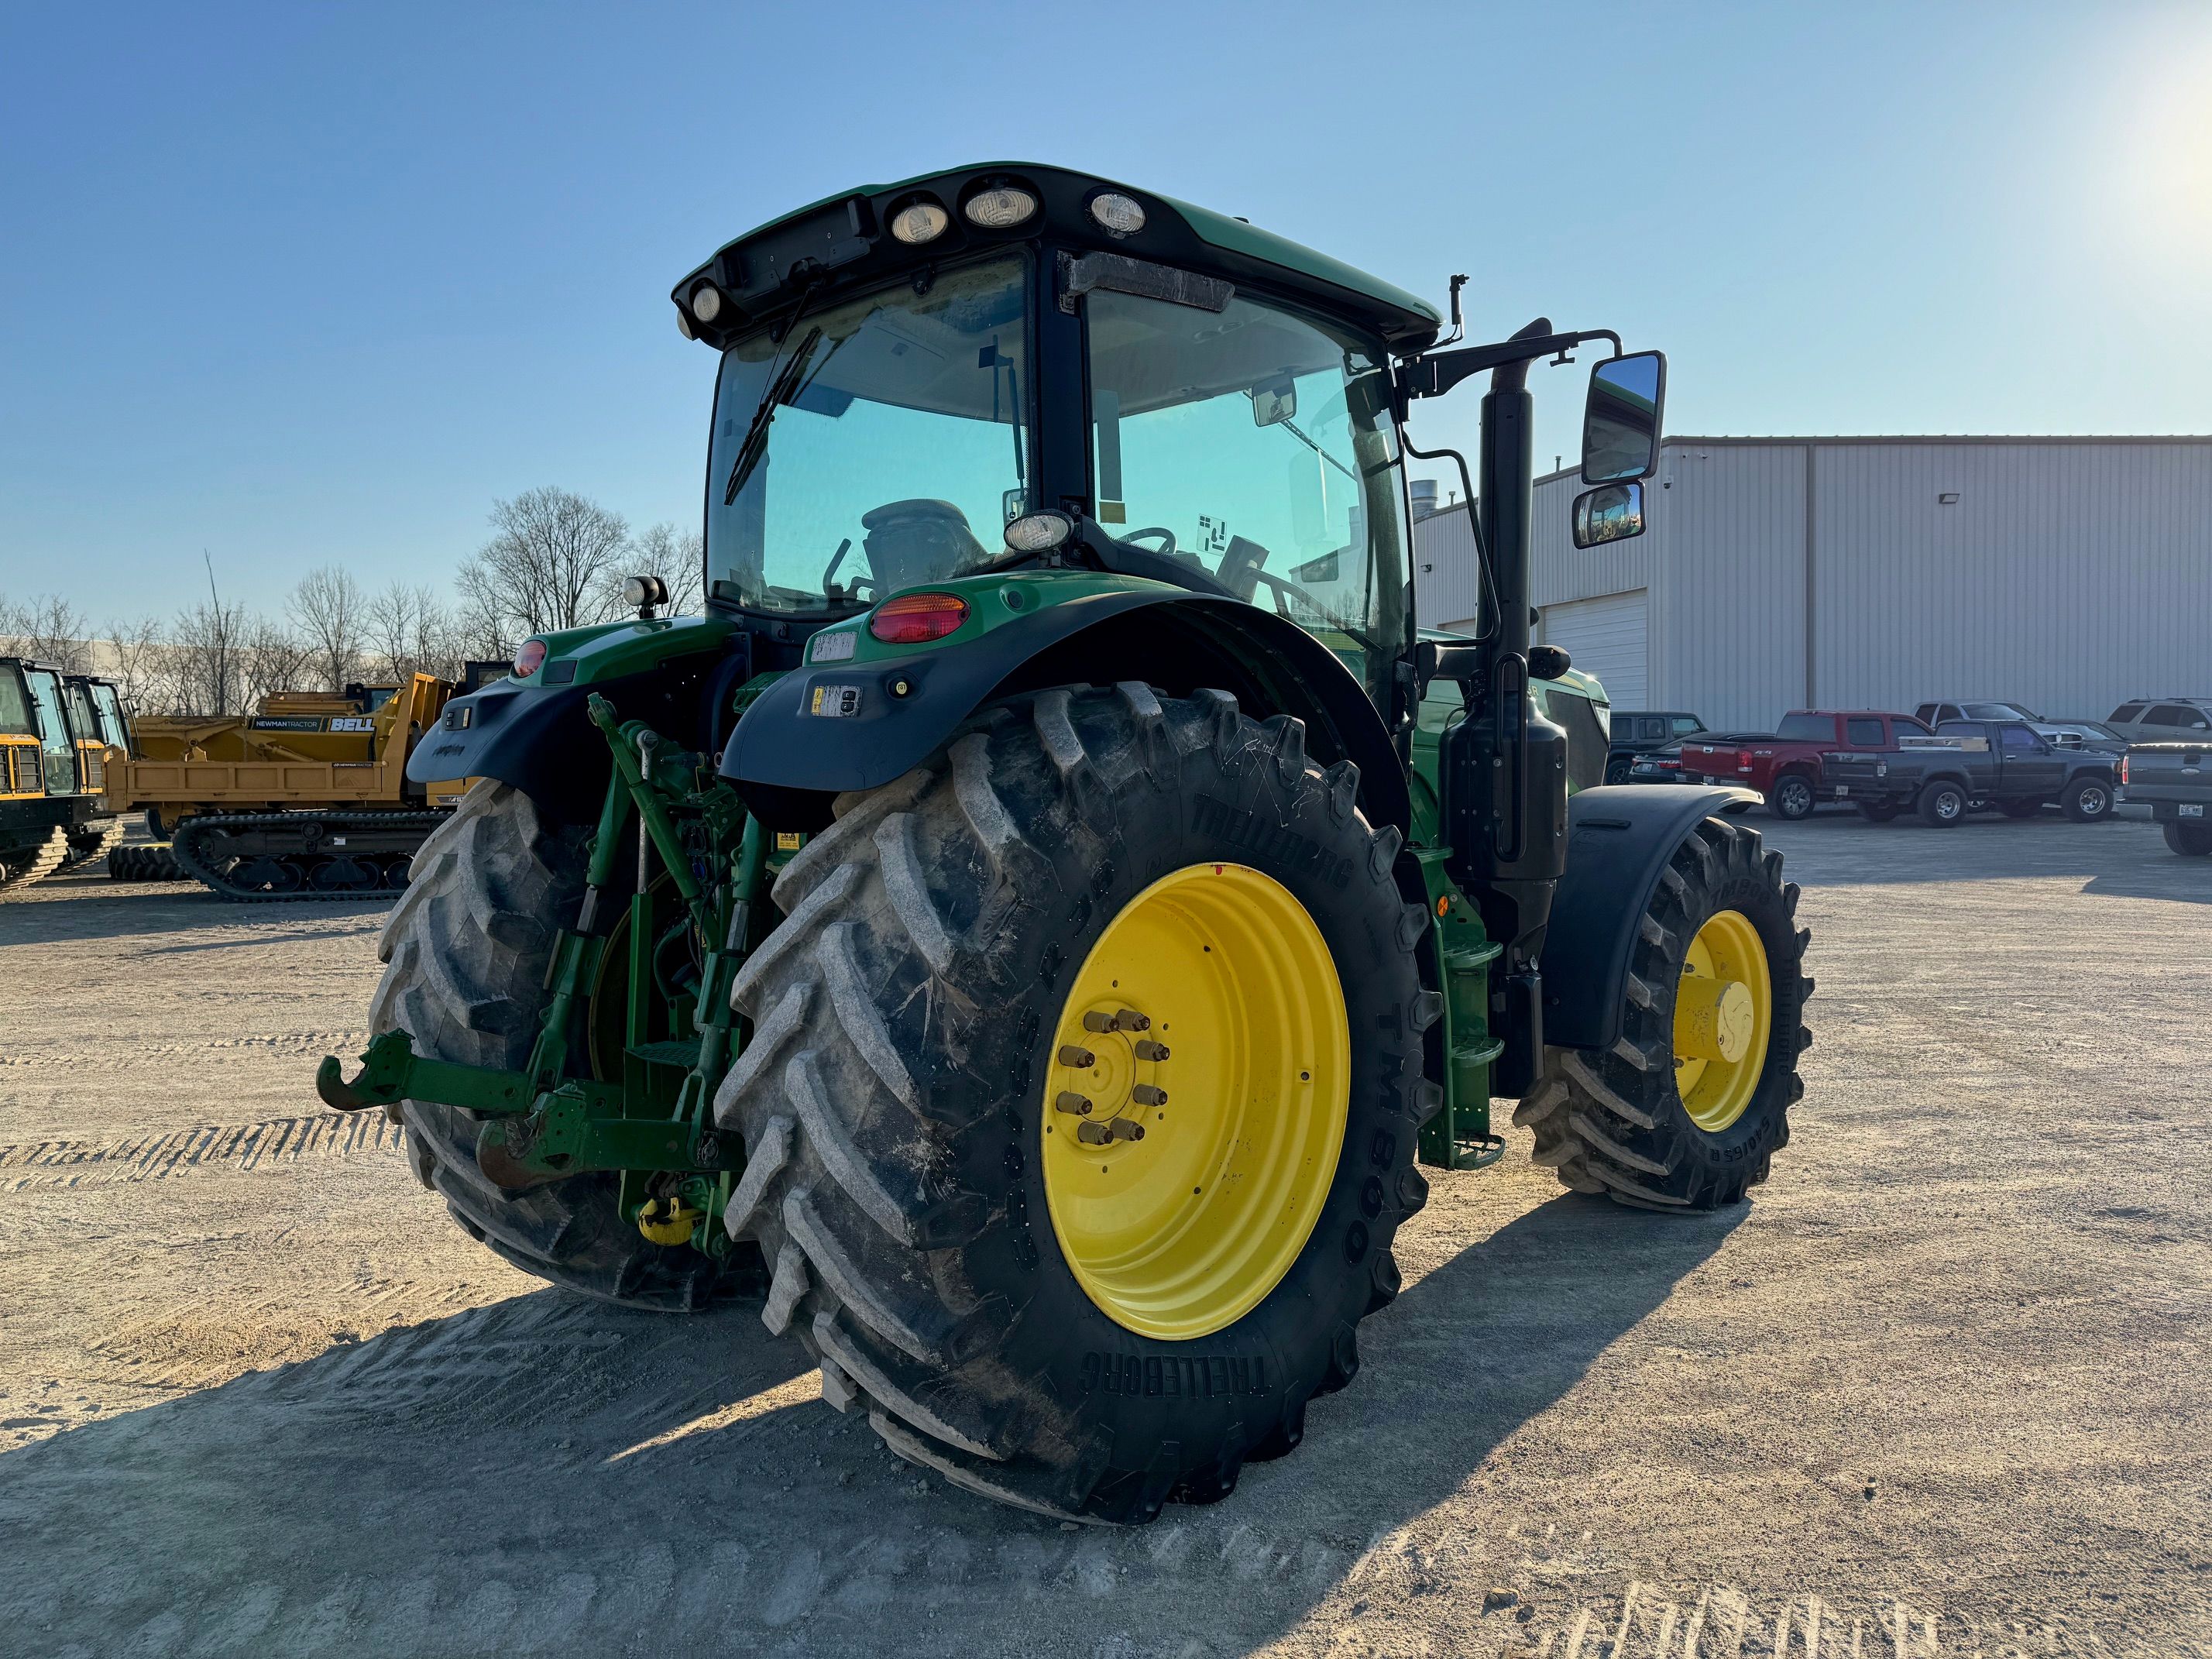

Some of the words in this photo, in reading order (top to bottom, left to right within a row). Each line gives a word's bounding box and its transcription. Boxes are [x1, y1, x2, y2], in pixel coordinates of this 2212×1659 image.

[330, 718, 376, 732] BELL
[1190, 792, 1355, 890] TRELLEBORG
[1078, 1350, 1274, 1400] TRELLEBORG
